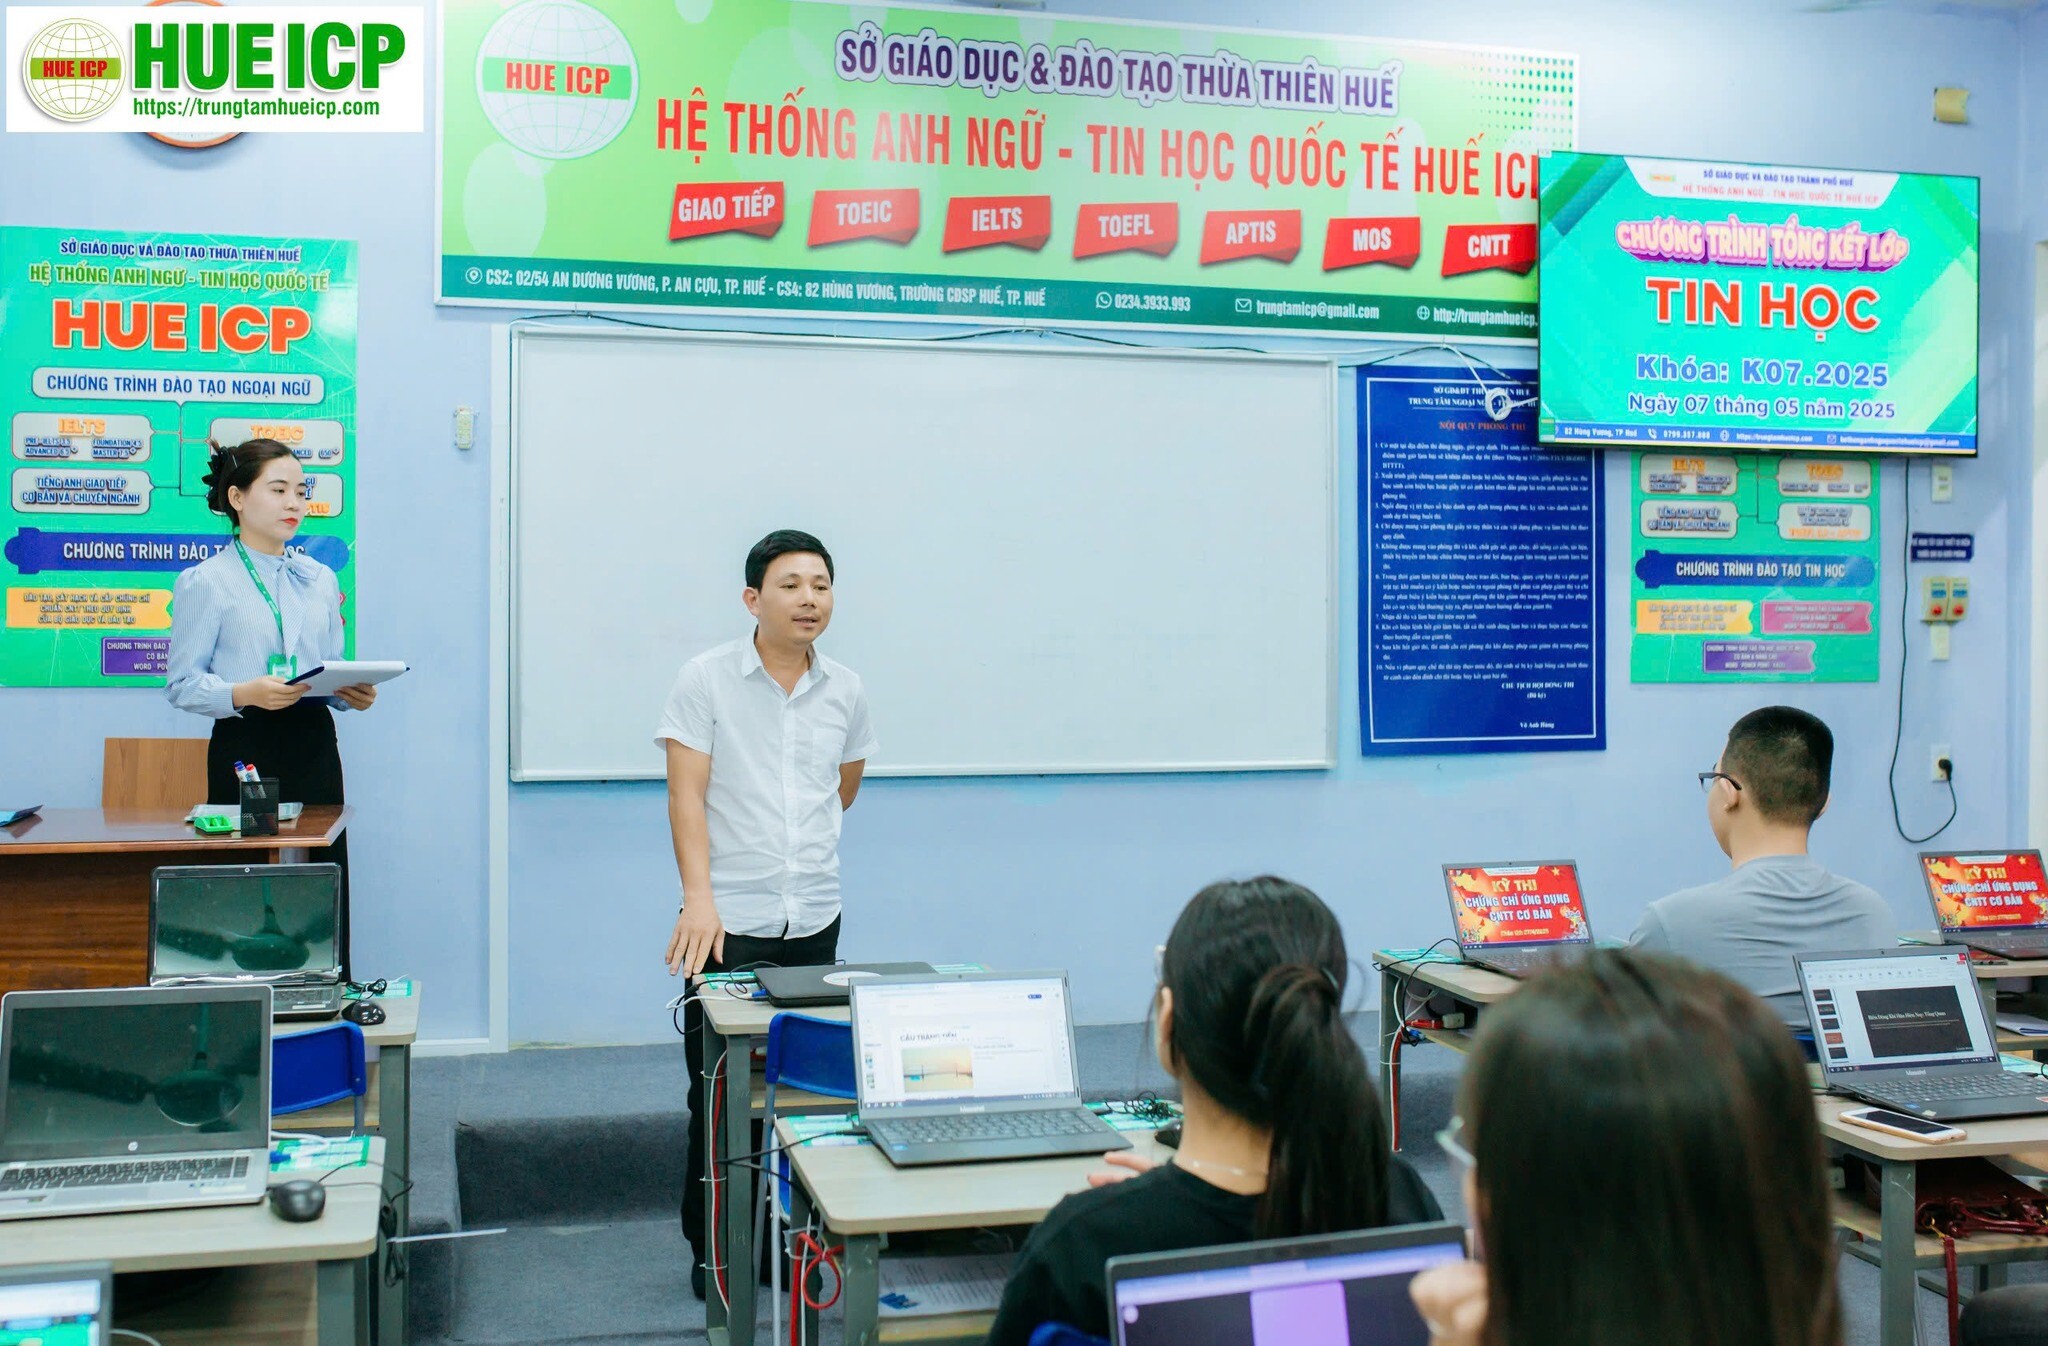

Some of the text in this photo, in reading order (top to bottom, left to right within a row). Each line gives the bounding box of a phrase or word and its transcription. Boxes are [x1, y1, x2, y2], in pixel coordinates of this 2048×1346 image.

[506, 62, 610, 95] HUE ICP
[842, 30, 1396, 108] SỞ GIÁO DỤC & ĐÀO TẠO THỪA THIÊN HUẾ
[657, 86, 708, 164] HỆ
[724, 86, 857, 160] THỐNG
[872, 110, 950, 165] ANH
[967, 108, 1046, 171] NGỮ
[1087, 124, 1144, 176] TIN
[1161, 129, 1234, 191] HỌC
[1250, 120, 1346, 189] QUỐC
[1361, 126, 1405, 191] TẾ
[1414, 133, 1485, 196] HUẾ
[678, 186, 776, 222] GIAO TIẾP
[836, 200, 892, 226] TOEIC
[972, 207, 1023, 232] IELTS
[1098, 213, 1154, 239] TOEFL
[1226, 220, 1276, 245] APTIS
[1353, 228, 1392, 252] MOS
[1617, 214, 1908, 263] CHƯƠNG TRÌNH TỔNG KẾT LỚP
[61, 238, 302, 262] SỞ GIÁO DỤC VÀ ĐÀO TẠO THỪA THIÊN HUẾ
[1467, 234, 1510, 258] CNTT
[30, 260, 330, 292] HỆ THỐNG ANH NGỮ TIN HỌC QUỐC TẾ
[486, 268, 1046, 307] CS2: 02/54 AN DƯƠNG VƯƠNG, P. AN CỰU, TP. HUẾ CS4: 82 HÙNG VƯƠNG, TRƯỜNG CĐSP HUẾ, TP. HUẾ
[1114, 293, 1190, 312] 0234.3933.993
[1256, 300, 1380, 319] trungtamicp@gmail.com
[1647, 280, 1878, 339] TIN HỌC
[53, 300, 312, 354] HUE ICP
[1638, 356, 1888, 386] Khóa: K07.2025
[47, 374, 312, 398] CHƯƠNG TRÌNH ĐÀO TẠO NGOẠI NGỮ
[1629, 394, 1895, 418] Ngày 07 tháng 05 năm 2025
[58, 418, 105, 434] IELTS
[252, 425, 304, 442] TOEIC
[1458, 422, 1476, 431] QUY
[65, 479, 82, 488] ANH
[86, 479, 106, 488] GIAO
[64, 542, 124, 558] CHƯƠNG
[130, 542, 173, 560] TRÌNH
[179, 542, 208, 560] ĐÀO
[1676, 560, 1846, 579] CHƯƠNG TRÌNH ĐÀO TẠO TIN HỌC
[1492, 878, 1537, 892] KỲ THI
[1984, 867, 2006, 879] THI
[1465, 892, 1570, 908] CHỨNG CHỈ ỨNG DỤNG
[1489, 910, 1514, 922] CNTT
